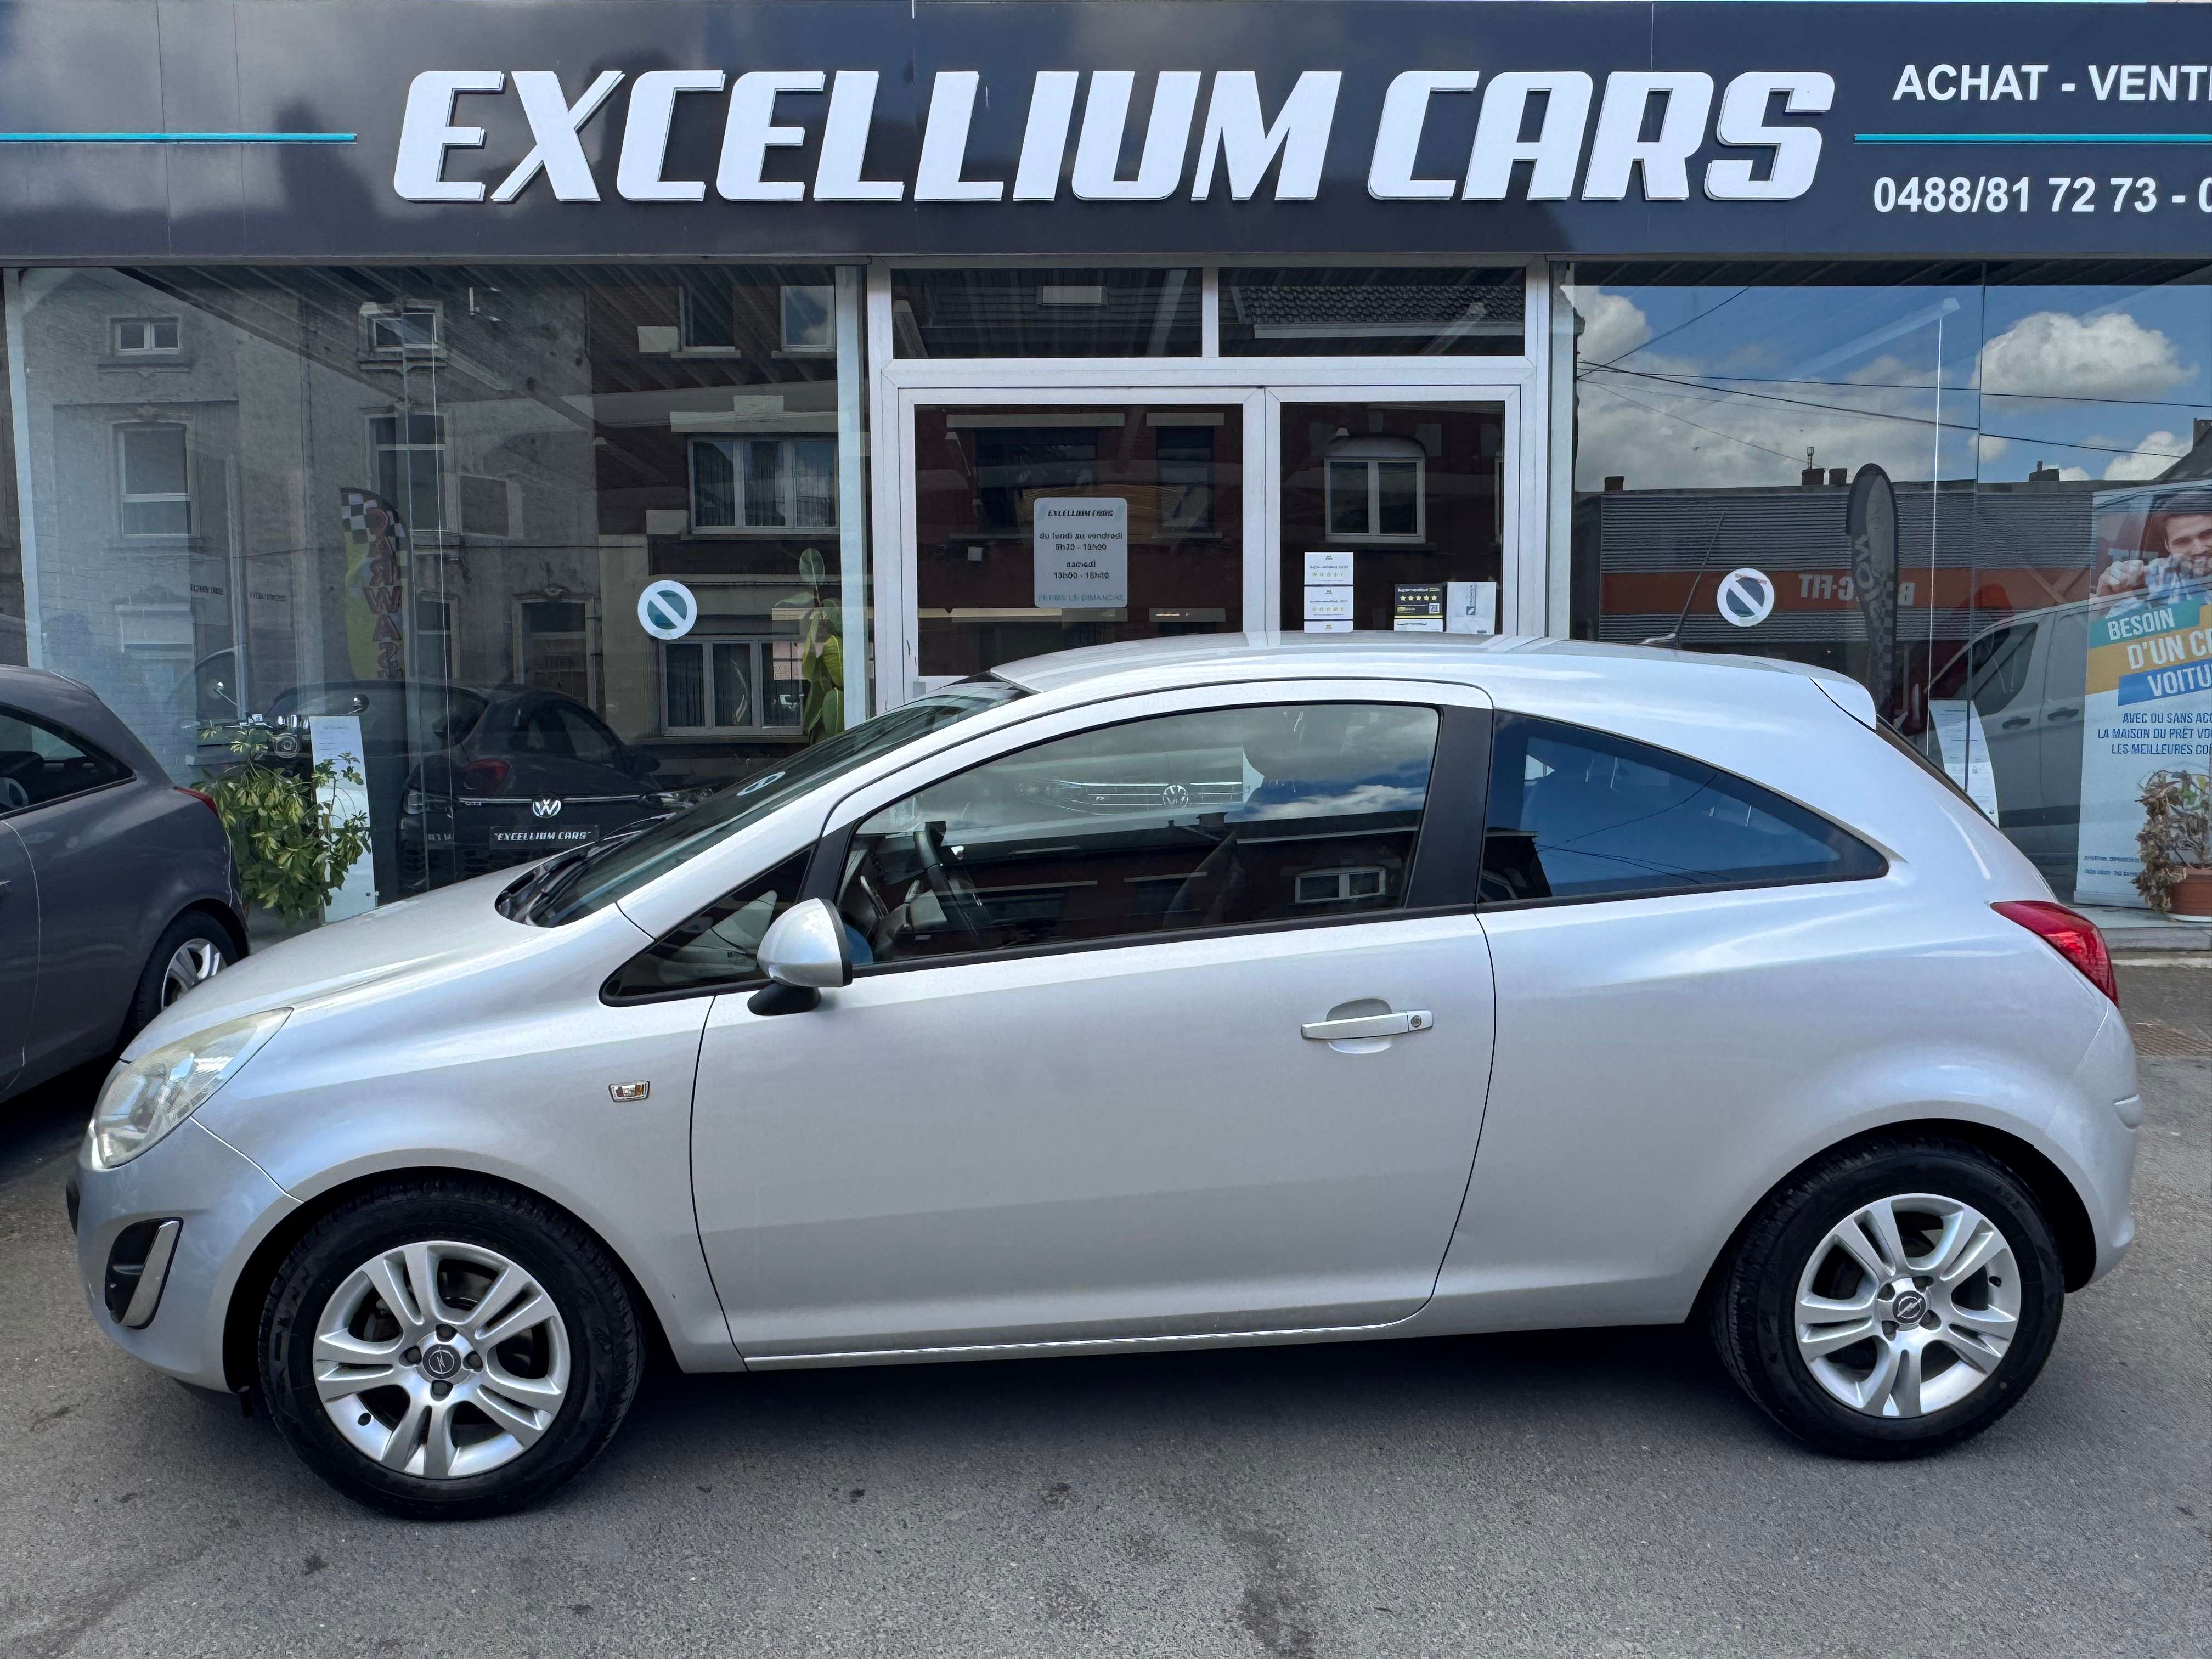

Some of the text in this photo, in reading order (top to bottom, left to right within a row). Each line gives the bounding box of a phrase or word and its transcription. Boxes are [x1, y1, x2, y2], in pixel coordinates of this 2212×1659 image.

[1892, 64, 2049, 101] ACHAT
[2088, 64, 2212, 101] VENT
[393, 70, 1835, 202] EXCELLIUM CARS
[1873, 176, 2029, 213] 0488/81
[2048, 177, 2096, 212] 72
[2110, 177, 2157, 213] 73
[1066, 559, 1096, 568] samedi
[2107, 608, 2175, 641] BESOIN
[2126, 635, 2186, 670] D'UN
[2147, 663, 2212, 697] VOITU
[2098, 725, 2212, 739] LA MAISON DU PRÊT VO
[2122, 713, 2148, 724] AVEC
[2151, 713, 2164, 724] OU
[2166, 713, 2193, 724] SANS
[2111, 743, 2129, 755] LES
[2131, 743, 2193, 755] MEILLEURES
